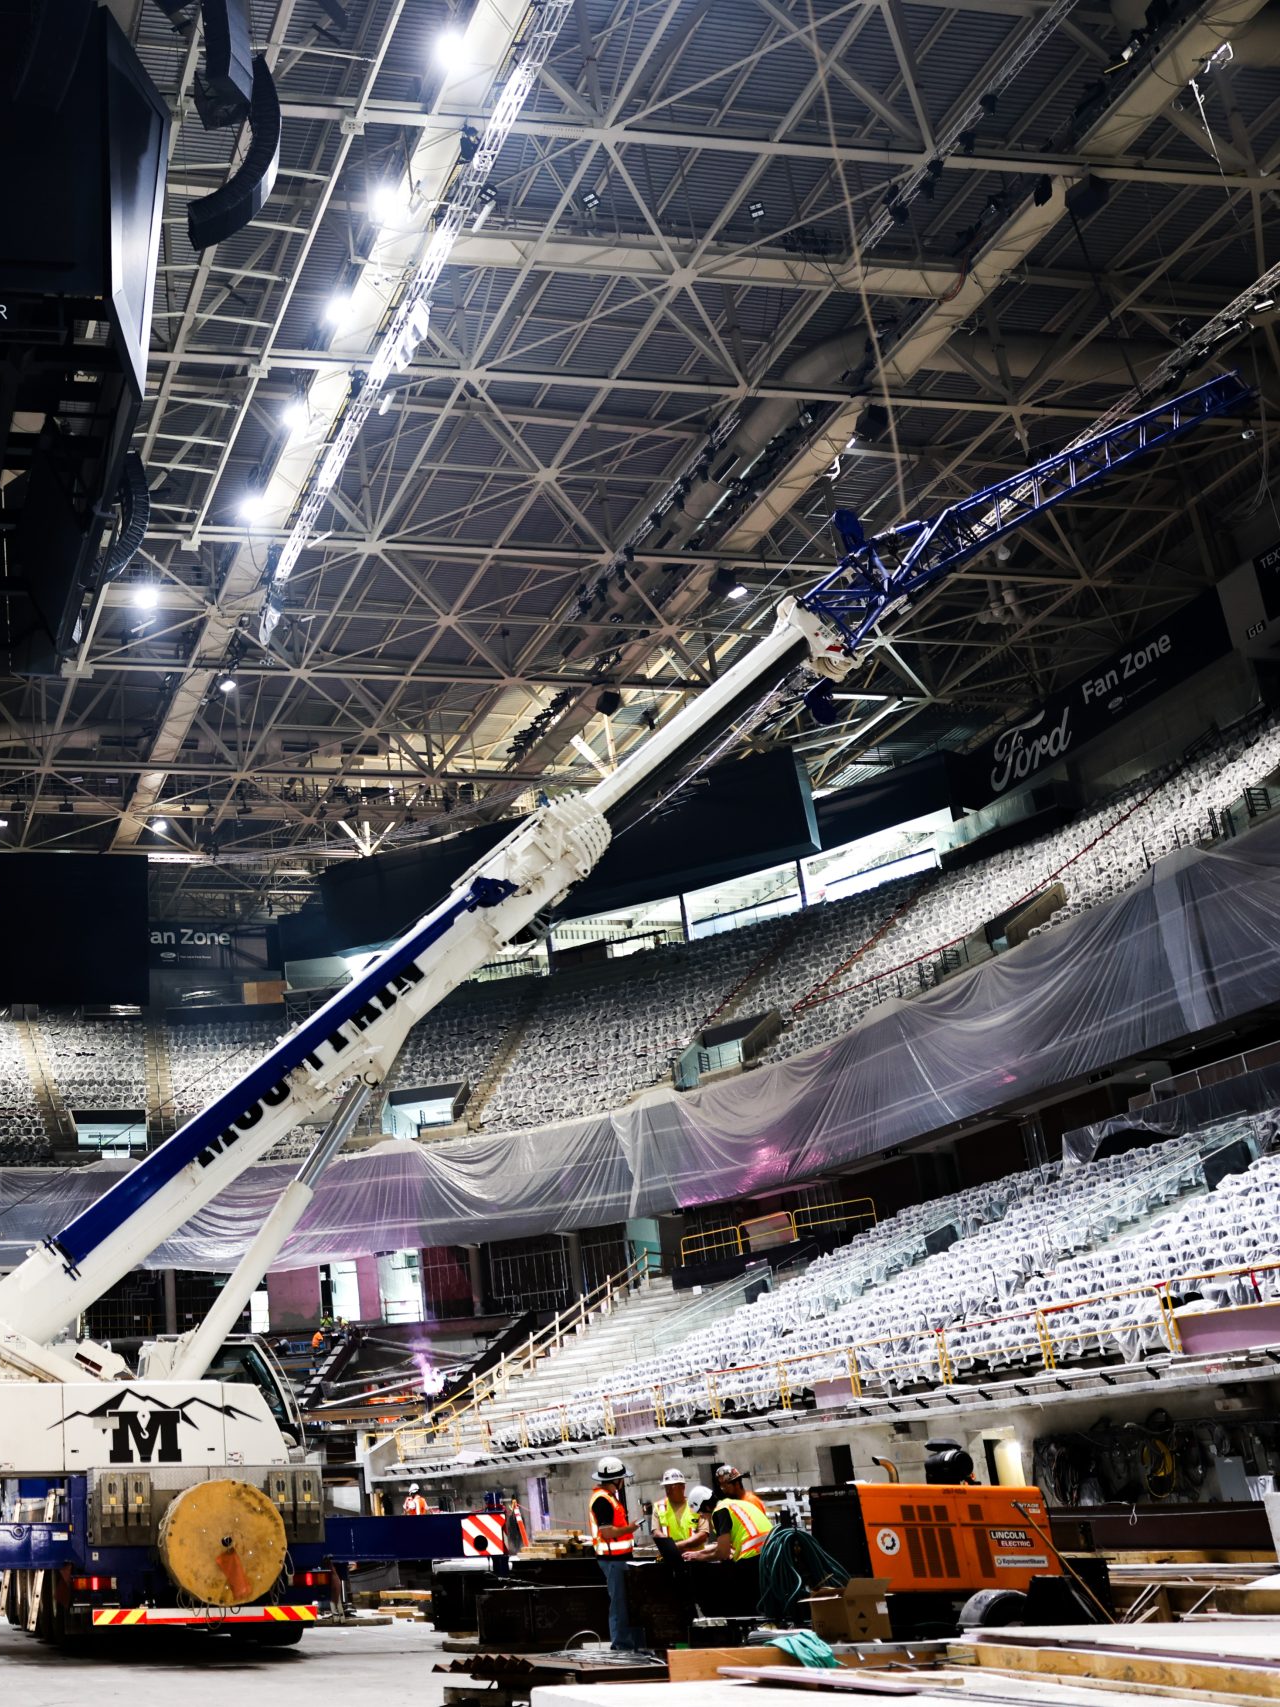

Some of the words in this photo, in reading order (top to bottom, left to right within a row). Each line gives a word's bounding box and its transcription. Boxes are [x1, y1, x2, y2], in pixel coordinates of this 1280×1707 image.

[1081, 669, 1119, 705] Fan
[1120, 633, 1172, 678] Zone
[990, 705, 1072, 792] Ford
[150, 931, 176, 945] an
[180, 929, 231, 945] Zone
[107, 1410, 182, 1463] M
[990, 1531, 1026, 1540] LINCOLN
